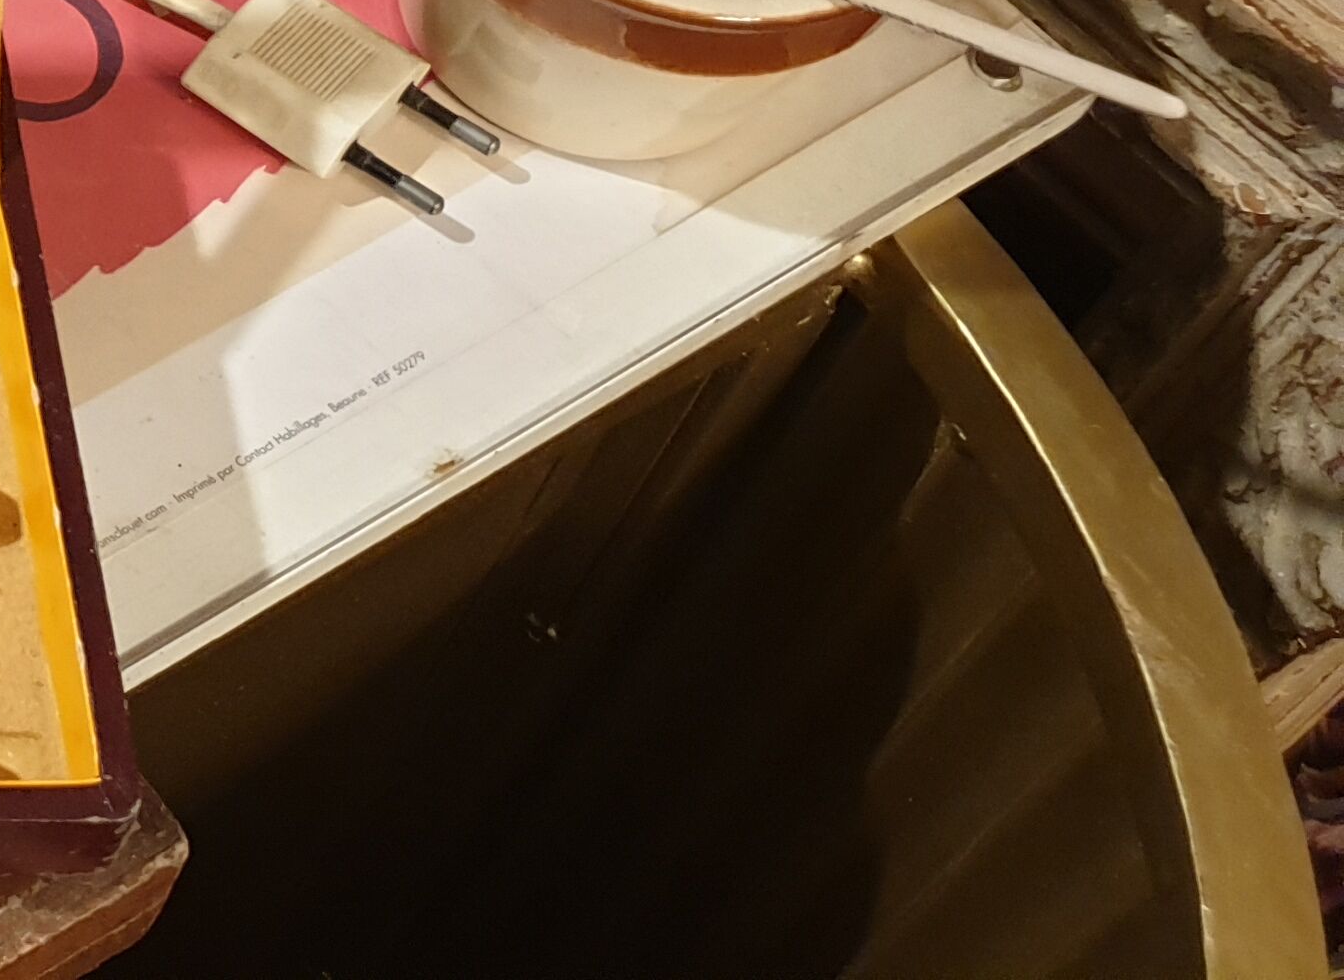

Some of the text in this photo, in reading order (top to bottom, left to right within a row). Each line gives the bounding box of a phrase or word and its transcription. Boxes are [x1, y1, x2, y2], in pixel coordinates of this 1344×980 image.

[216, 464, 235, 482] par
[234, 441, 275, 467] Contact
[327, 389, 367, 413] Beaune
[371, 369, 391, 387] REF
[392, 350, 425, 376] 50279
